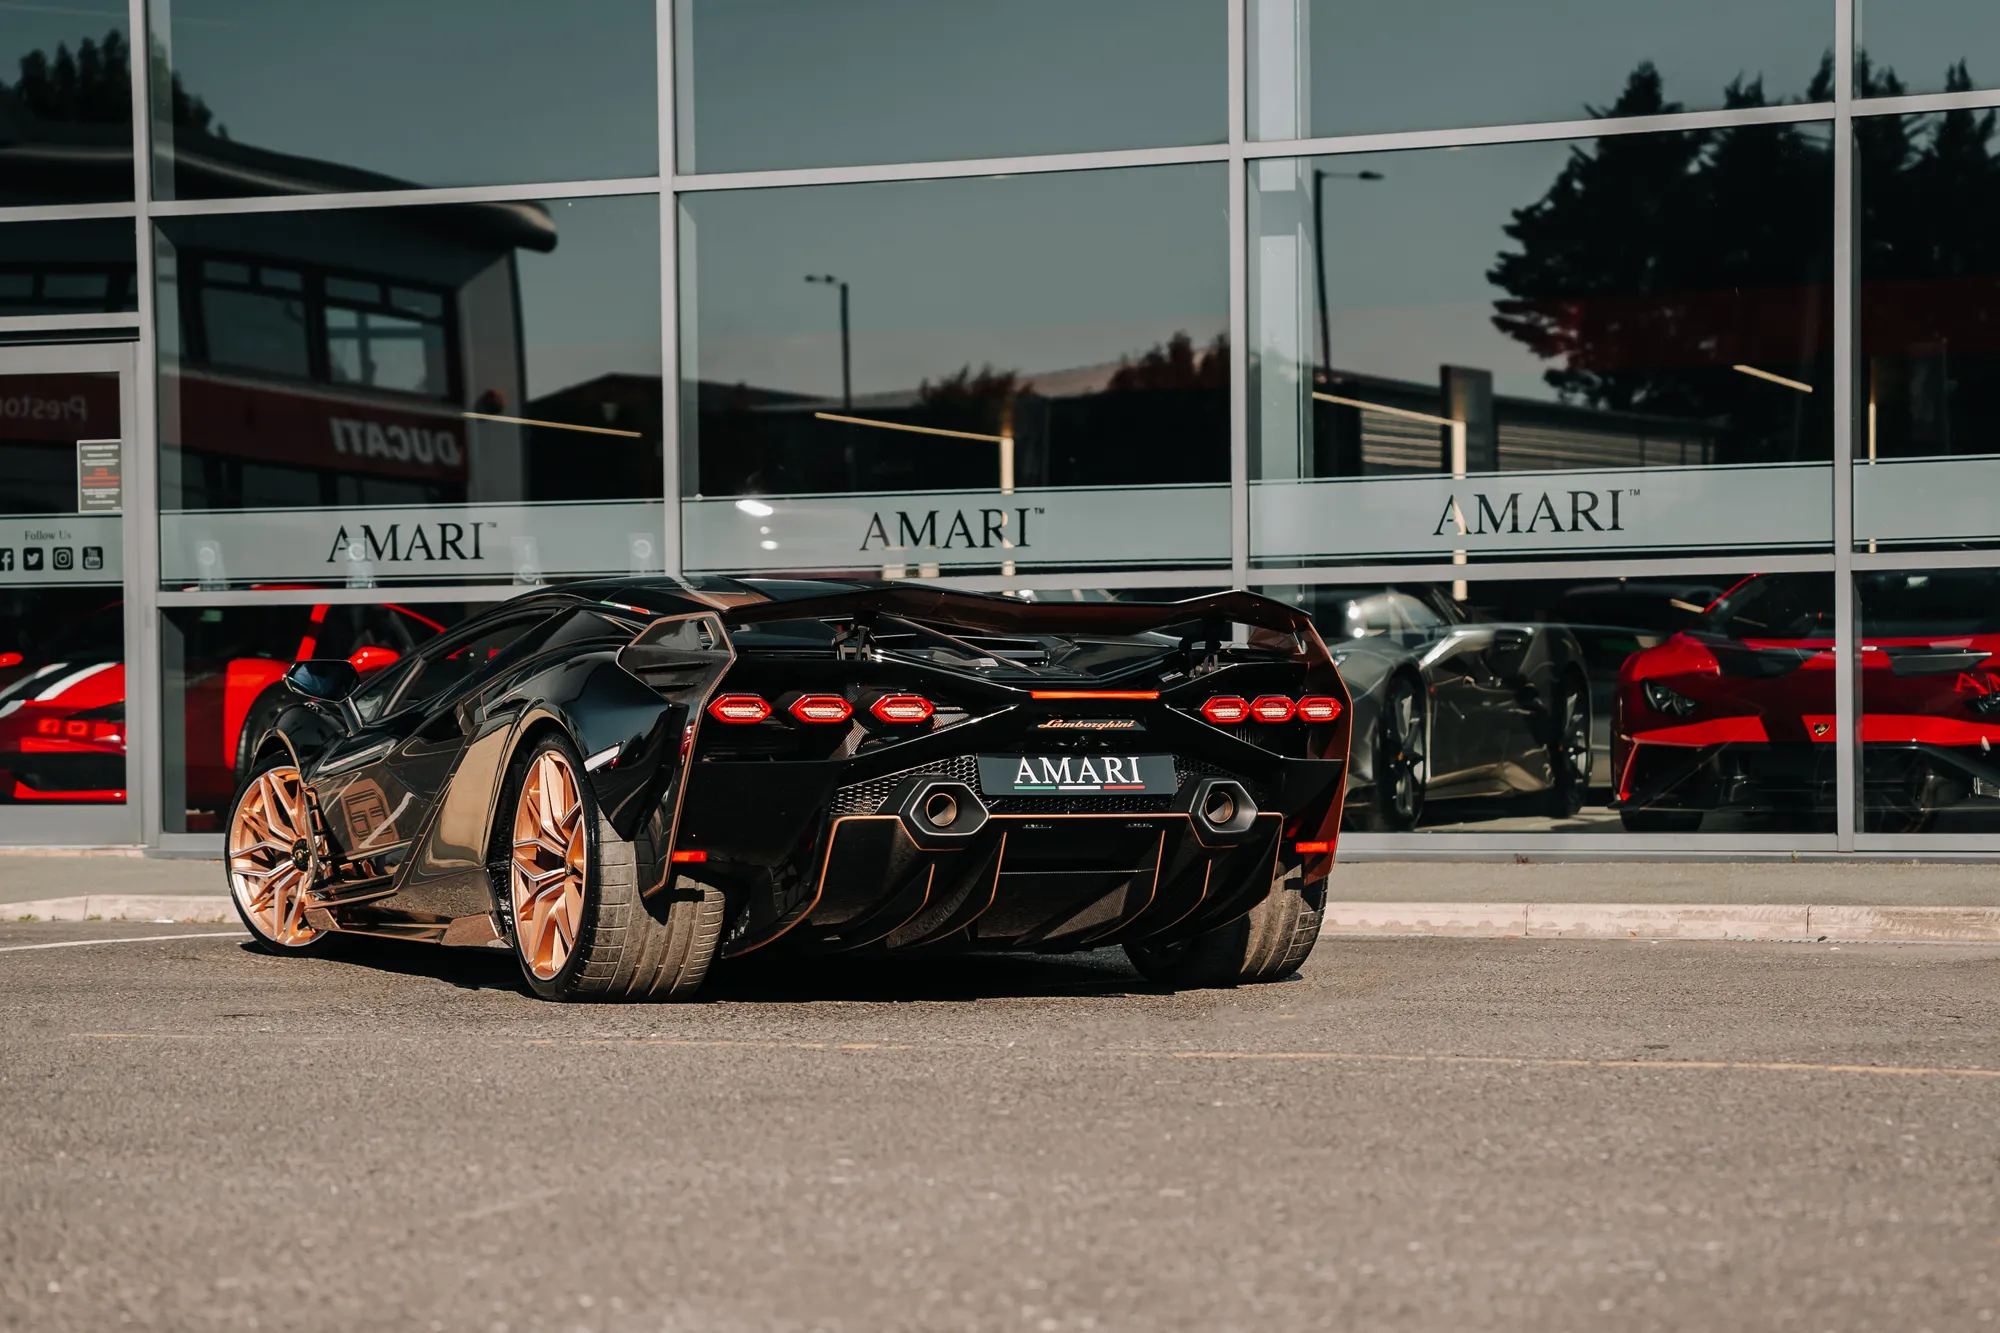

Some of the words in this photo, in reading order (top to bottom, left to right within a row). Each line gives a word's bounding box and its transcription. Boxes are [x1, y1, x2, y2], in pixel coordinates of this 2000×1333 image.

[859, 508, 1031, 550] AMARI
[1433, 490, 1625, 535] AMARI
[24, 530, 55, 540] Follow
[59, 530, 72, 539] Us
[326, 521, 485, 563] AMARI
[1037, 719, 1135, 730] Lamborghini
[1013, 756, 1144, 784] AMARI
